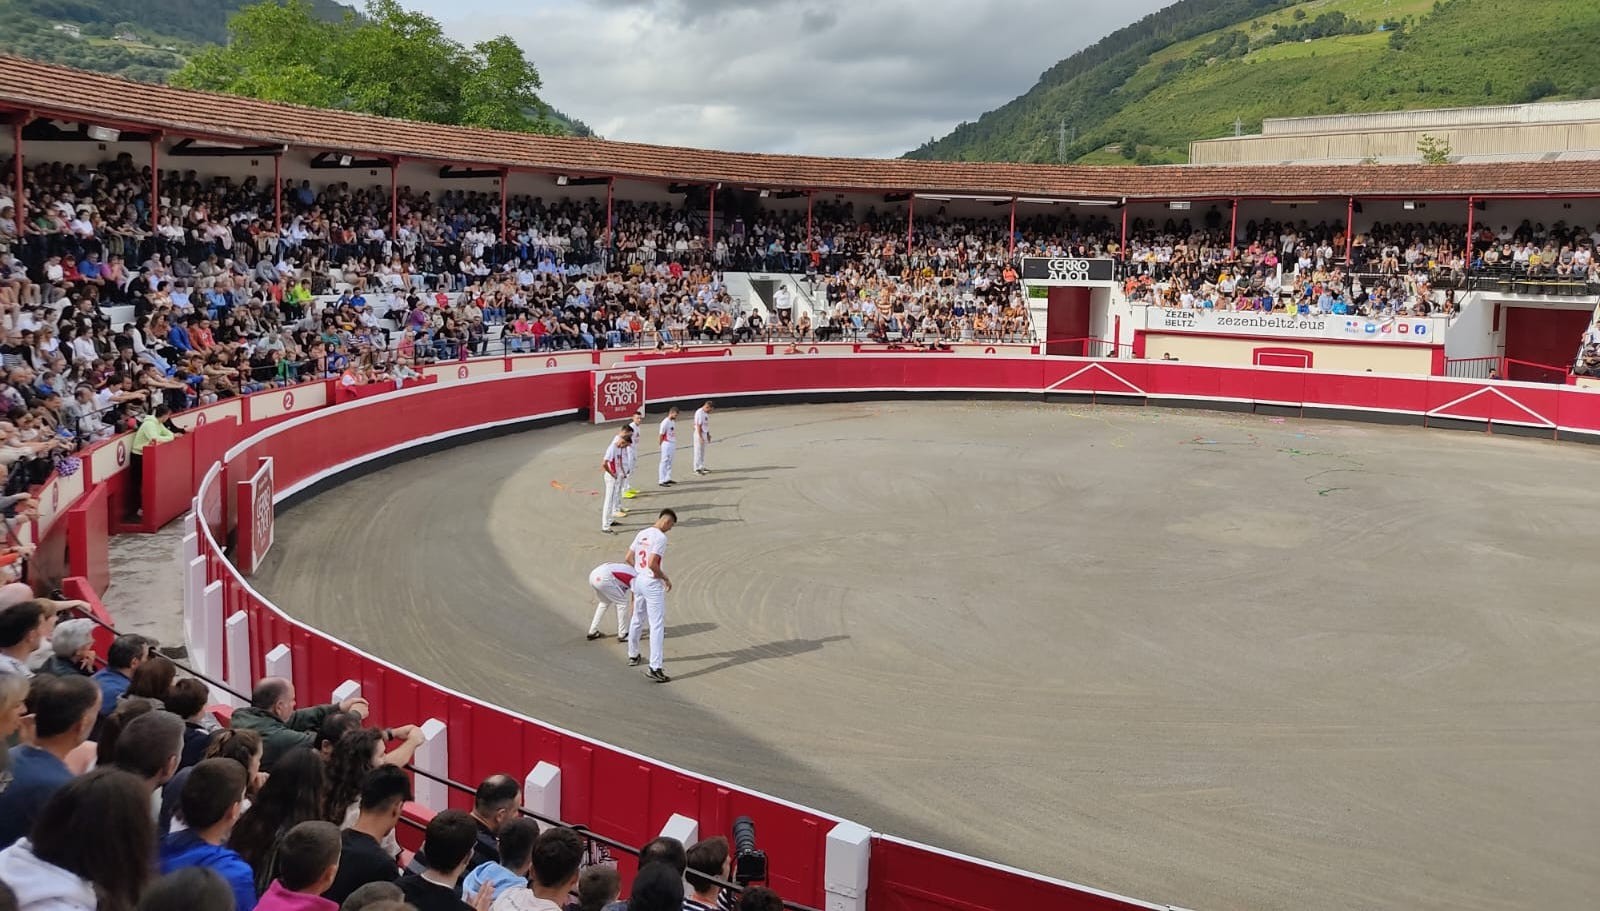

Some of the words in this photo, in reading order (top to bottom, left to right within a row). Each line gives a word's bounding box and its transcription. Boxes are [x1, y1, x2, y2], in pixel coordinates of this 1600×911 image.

[1047, 260, 1090, 272] CERRO
[1165, 309, 1195, 319] ZEZEN
[1217, 316, 1325, 330] zezenbeltz.eus
[604, 380, 638, 396] CERRO
[284, 393, 291, 408] 2
[639, 550, 646, 568] 3
